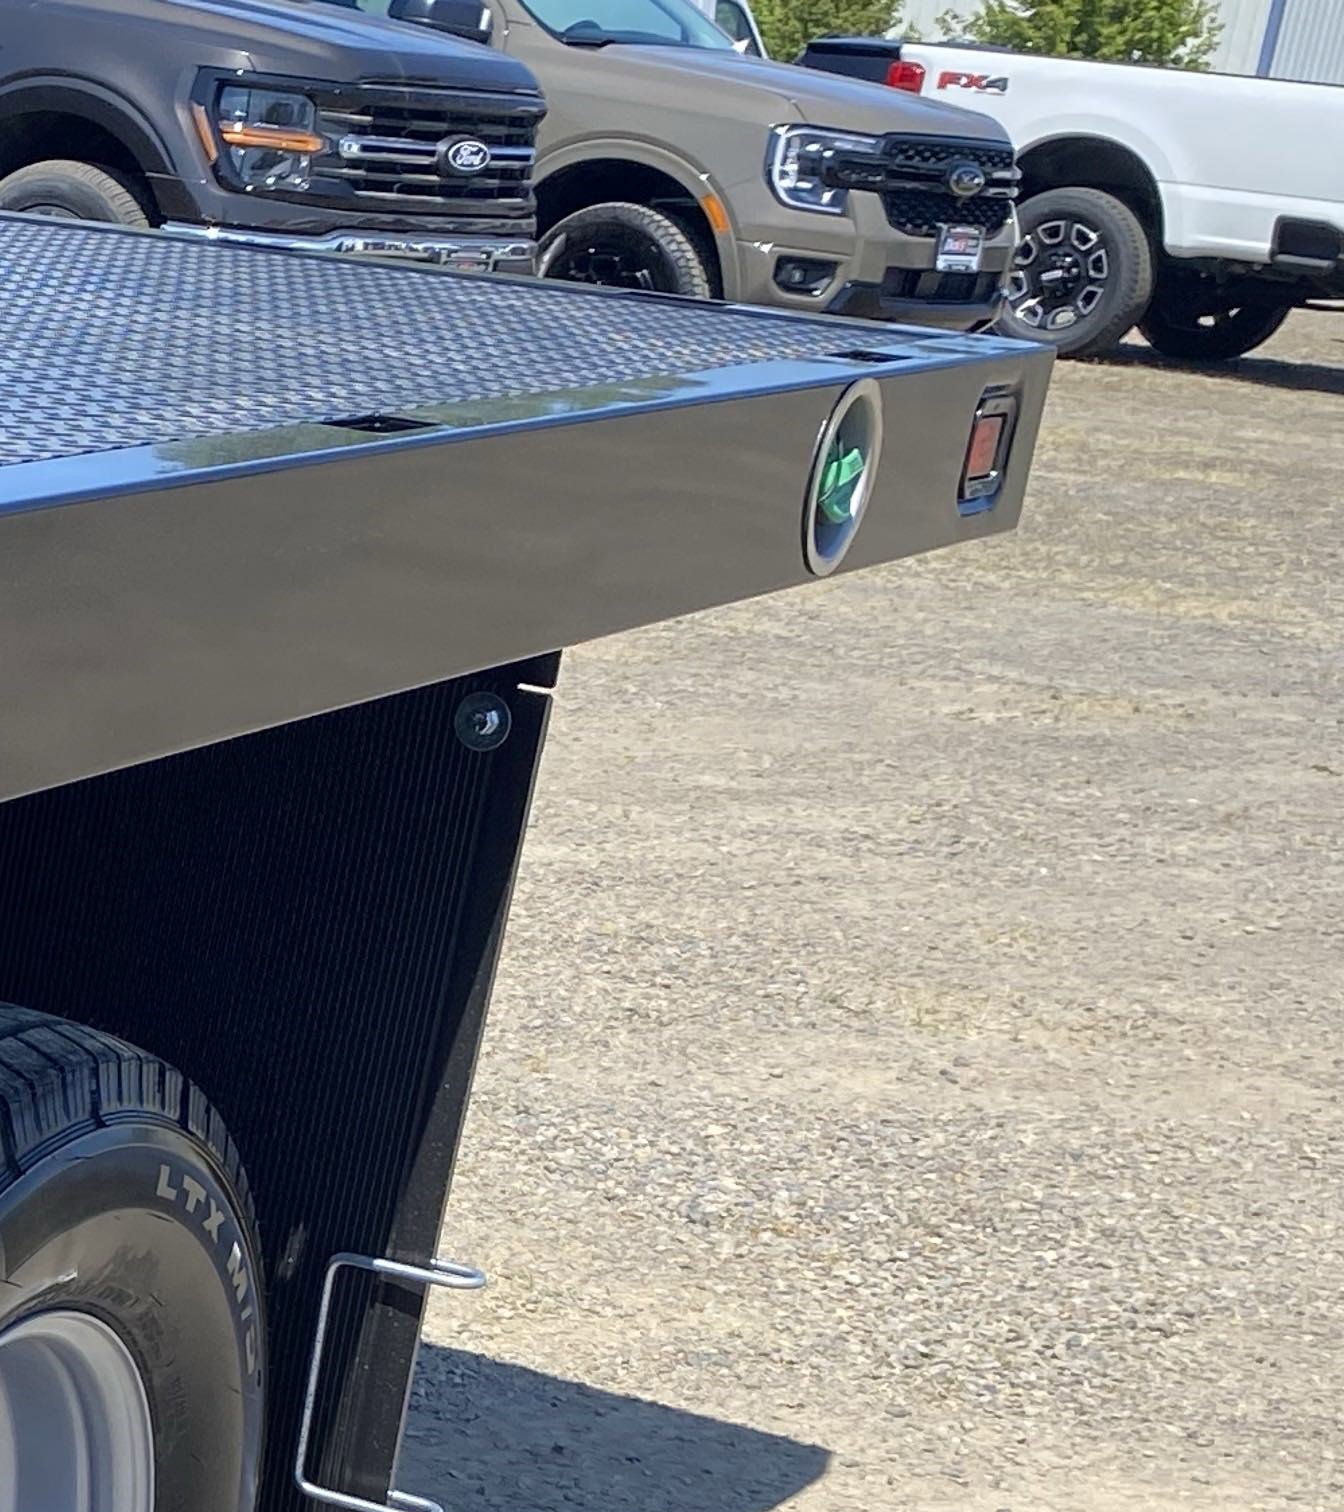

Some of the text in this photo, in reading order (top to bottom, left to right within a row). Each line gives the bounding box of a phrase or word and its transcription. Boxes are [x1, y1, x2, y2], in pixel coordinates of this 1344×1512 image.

[936, 71, 1009, 92] FX4
[453, 142, 486, 168] Ford
[155, 1163, 226, 1244] LTX
